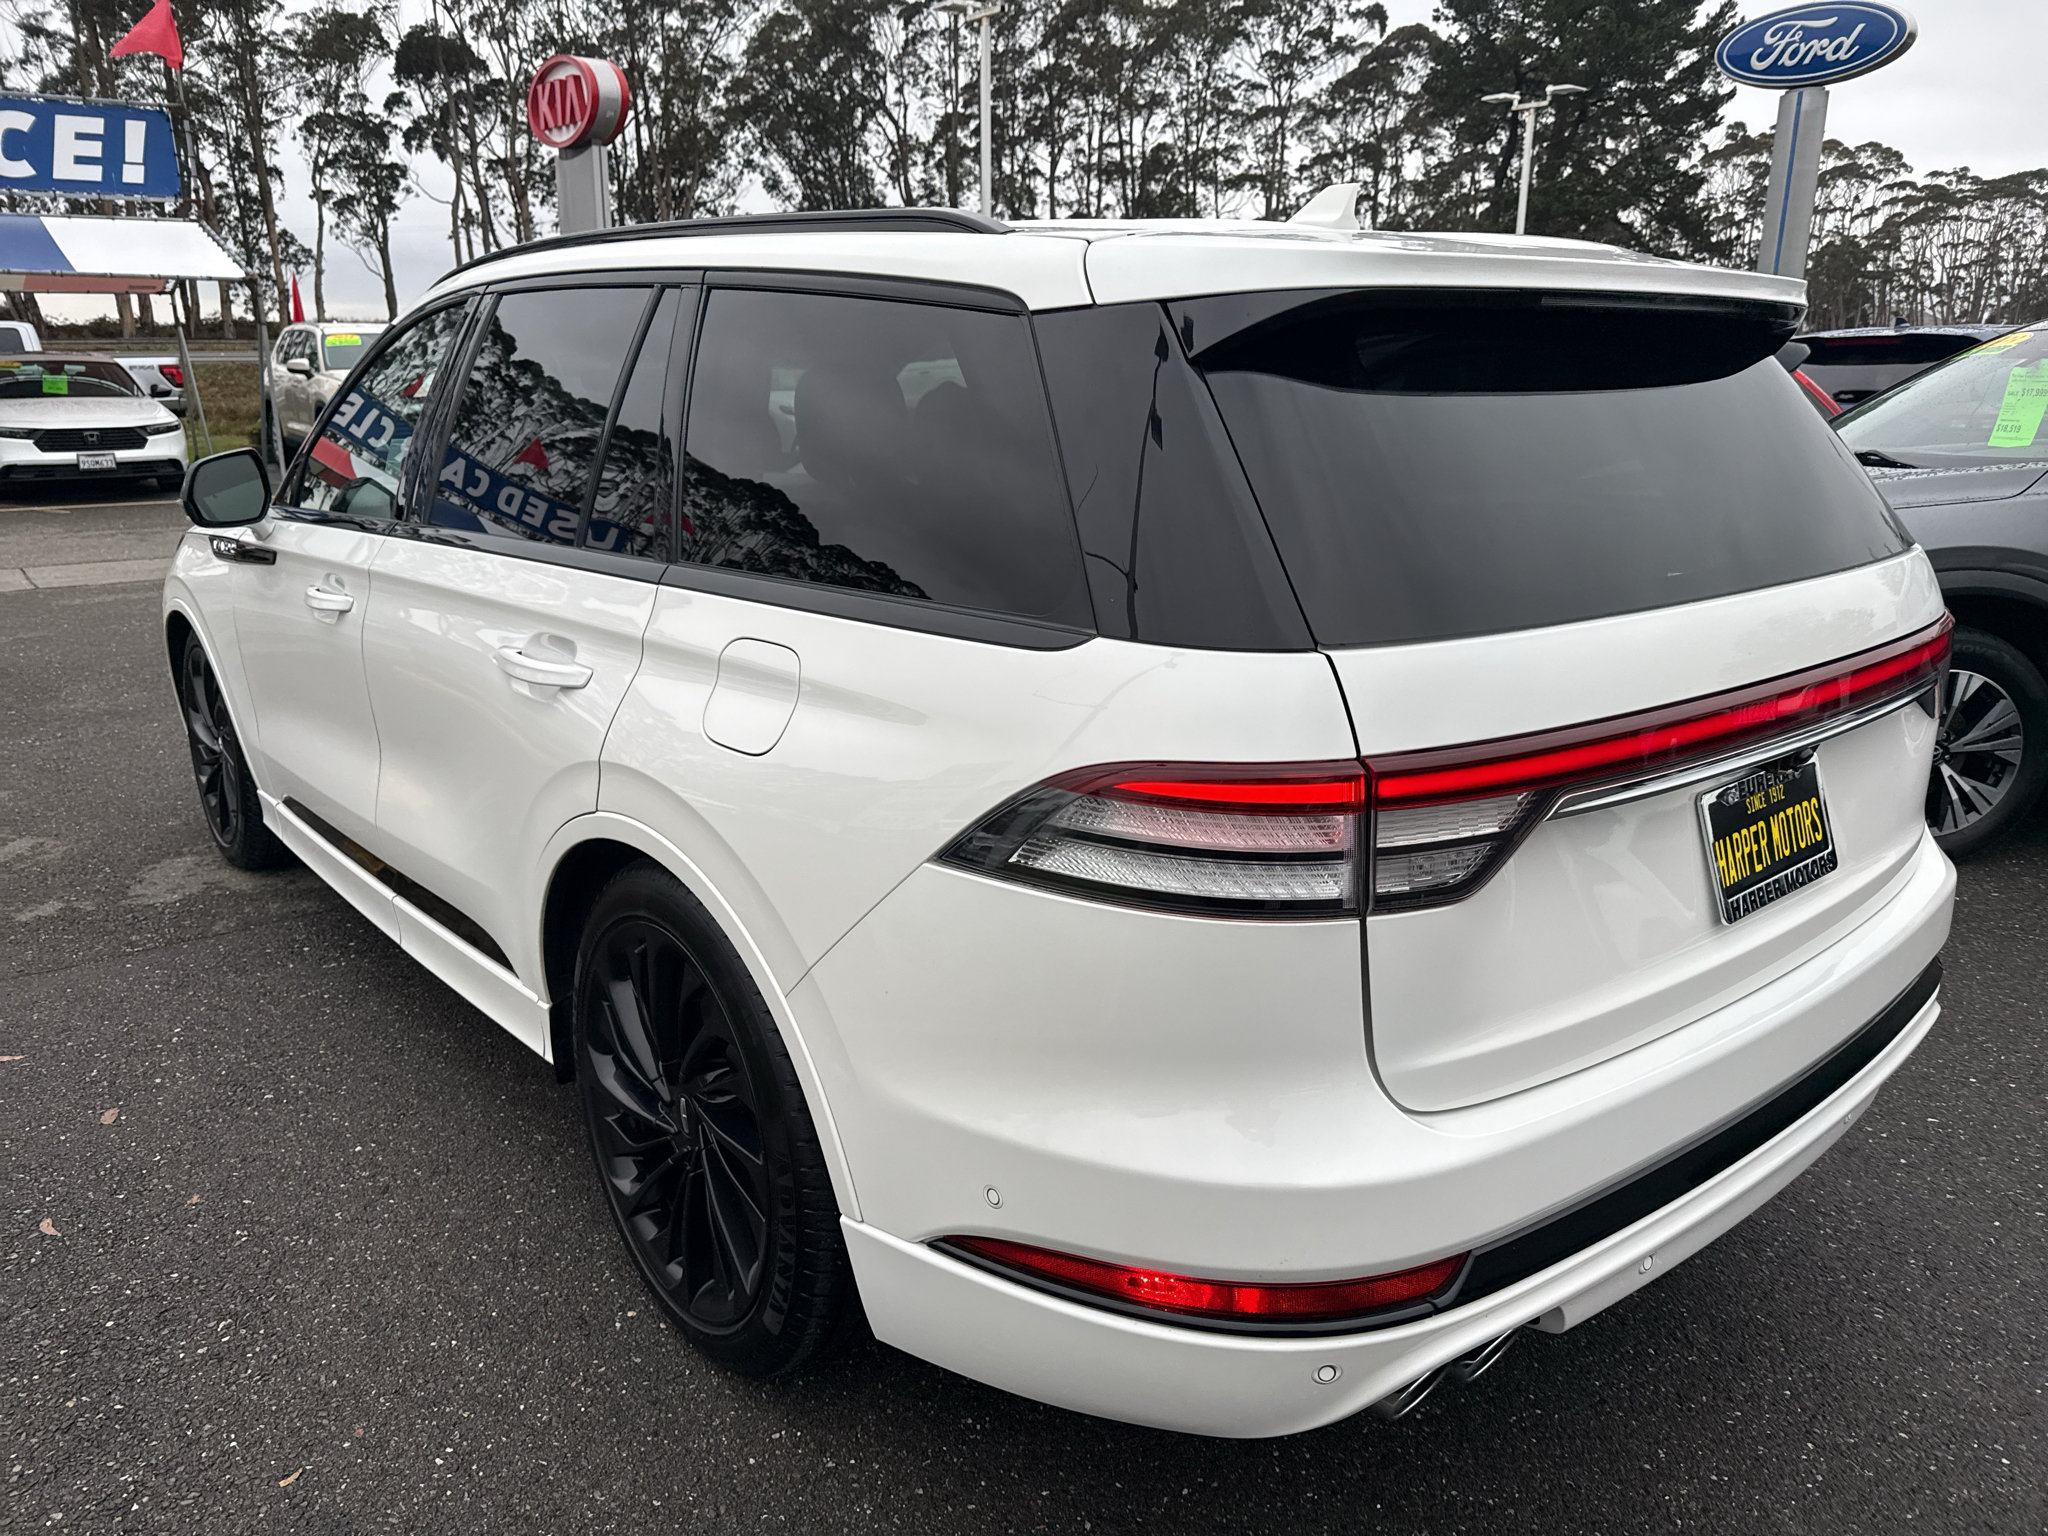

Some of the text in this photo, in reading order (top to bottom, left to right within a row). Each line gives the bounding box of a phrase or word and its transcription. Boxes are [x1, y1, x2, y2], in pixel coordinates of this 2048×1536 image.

[1751, 17, 1866, 71] Ford
[536, 75, 583, 130] KIA
[0, 110, 146, 184] CE!
[1746, 784, 1785, 814] SINCE 1912
[1715, 797, 1823, 888] HARPER MOTORS
[1731, 853, 1833, 921] HARPER MOTORS
